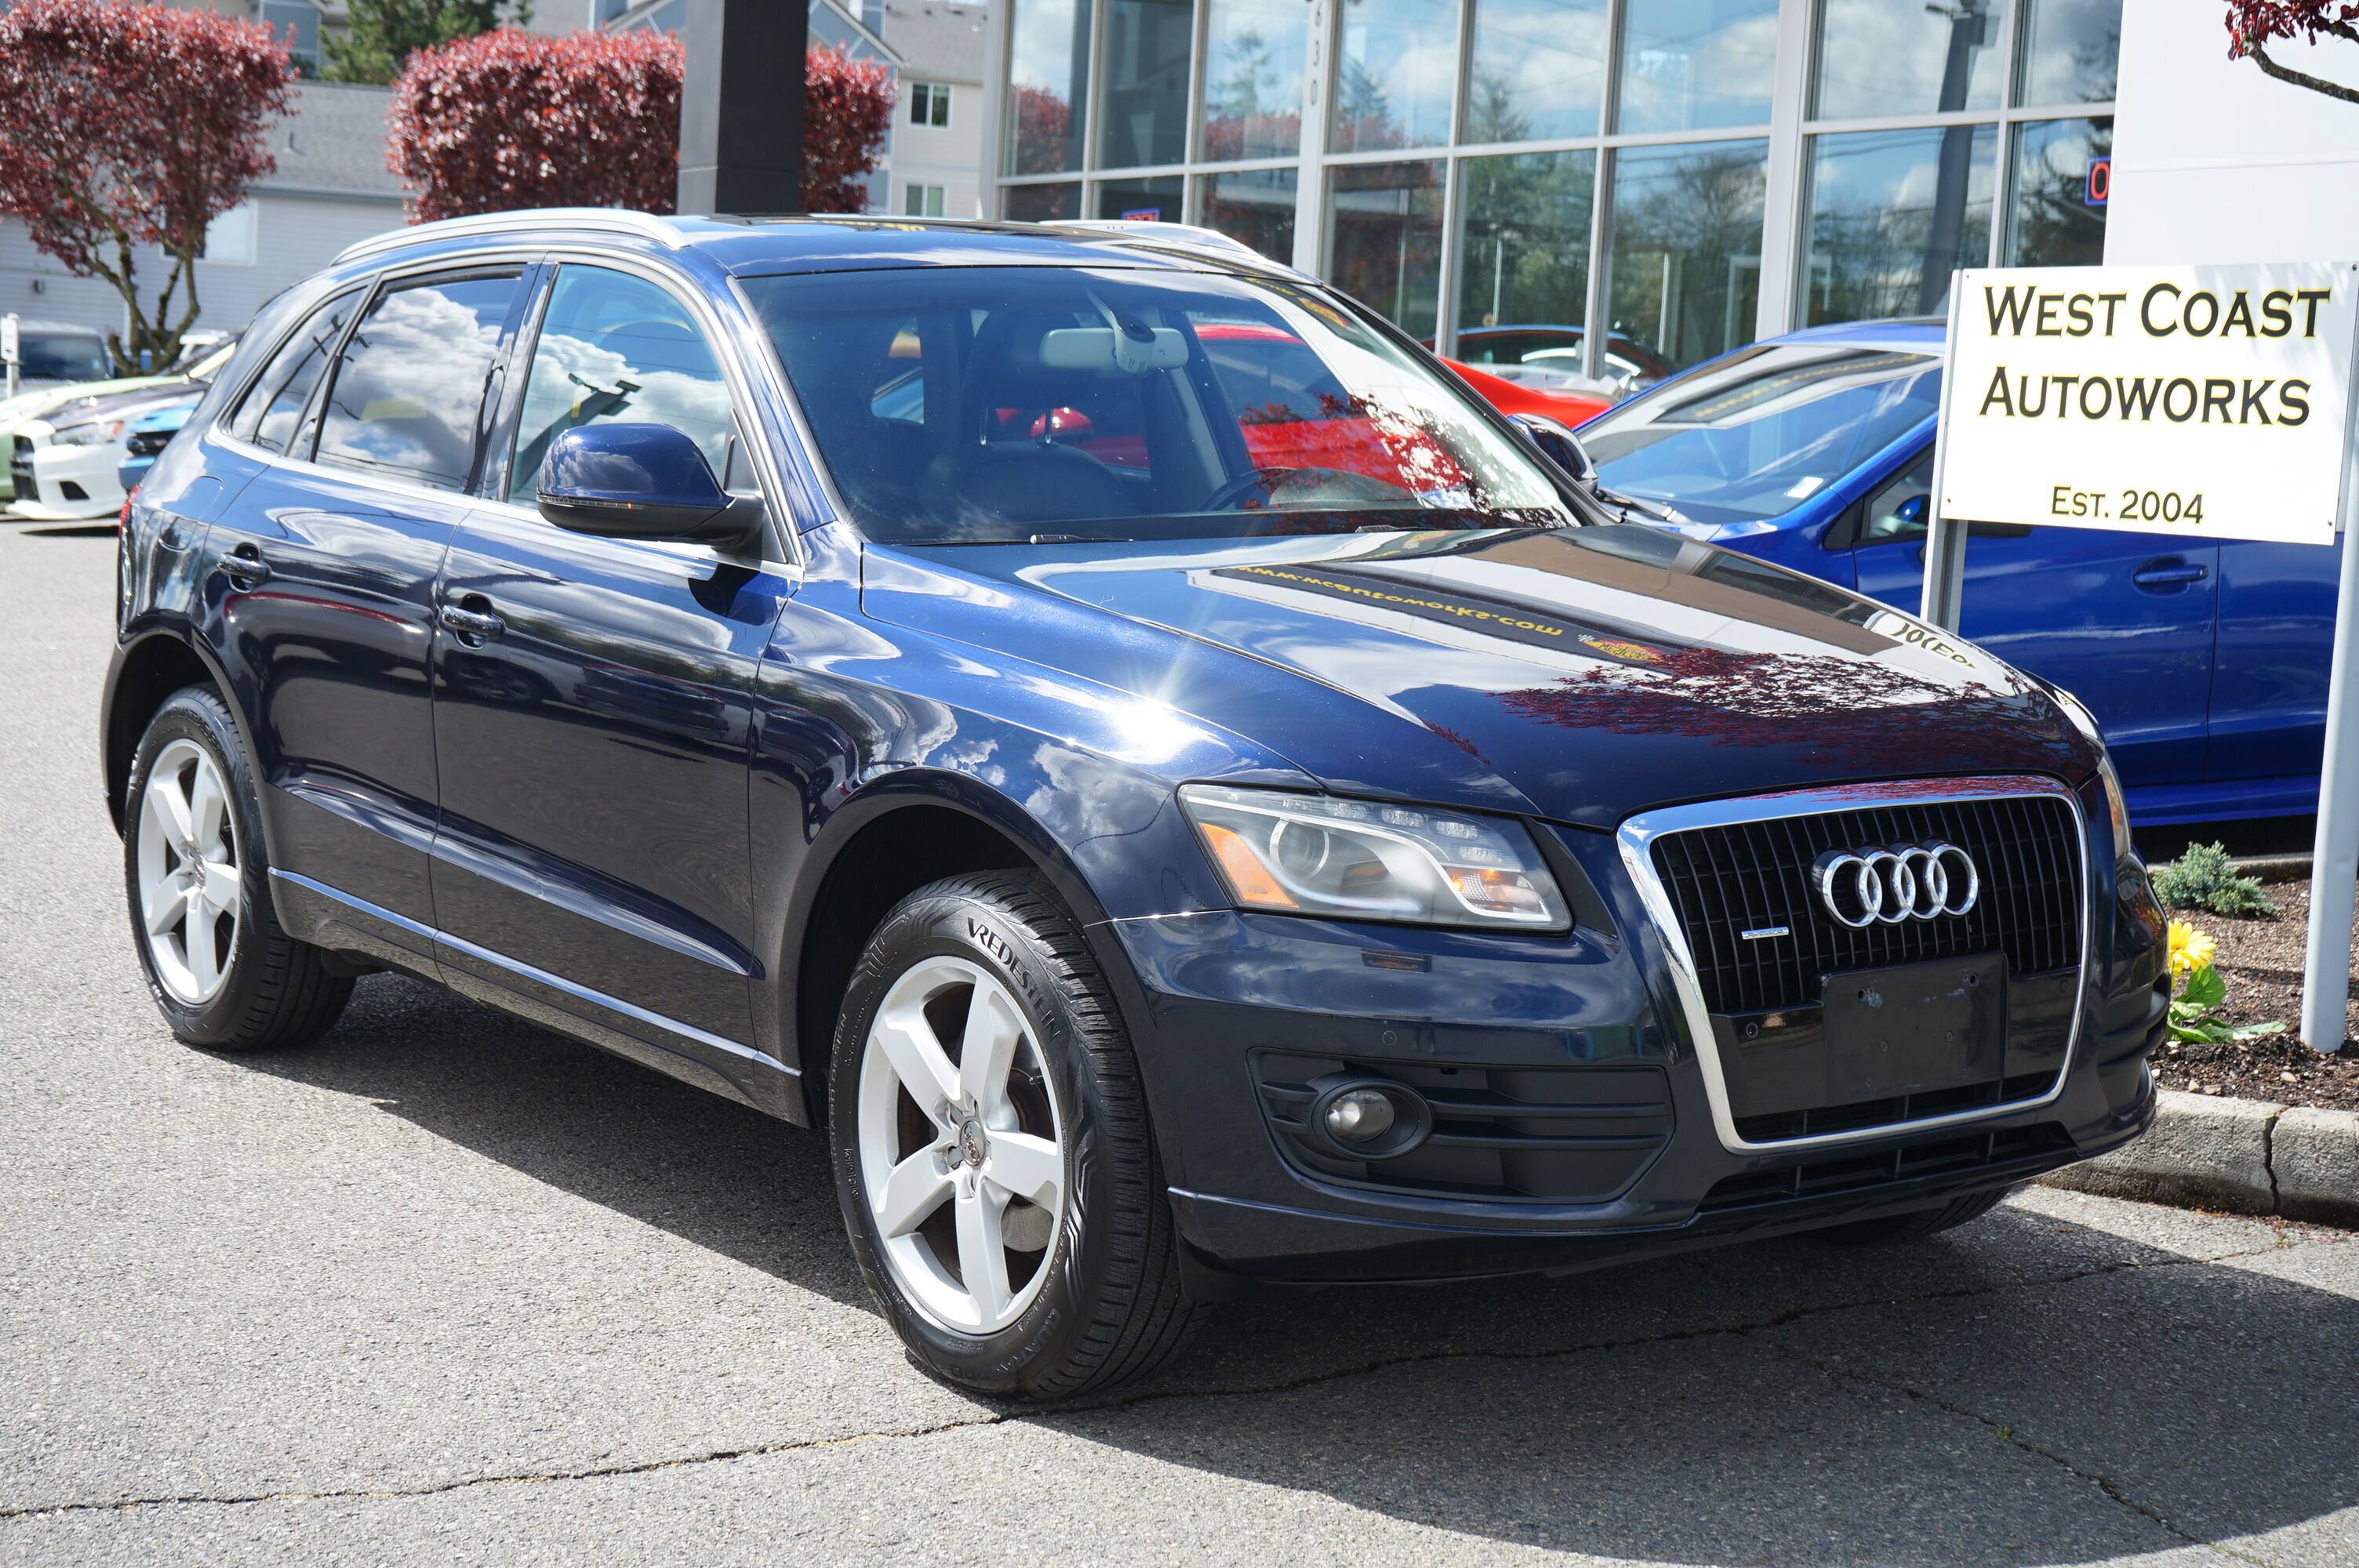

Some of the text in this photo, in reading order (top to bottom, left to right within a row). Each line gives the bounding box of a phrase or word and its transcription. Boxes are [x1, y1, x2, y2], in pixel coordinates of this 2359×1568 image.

[1983, 282, 2331, 338] WEST COAST
[1979, 365, 2312, 426] AUTOWORKS
[2051, 485, 2204, 524] EST. 2004
